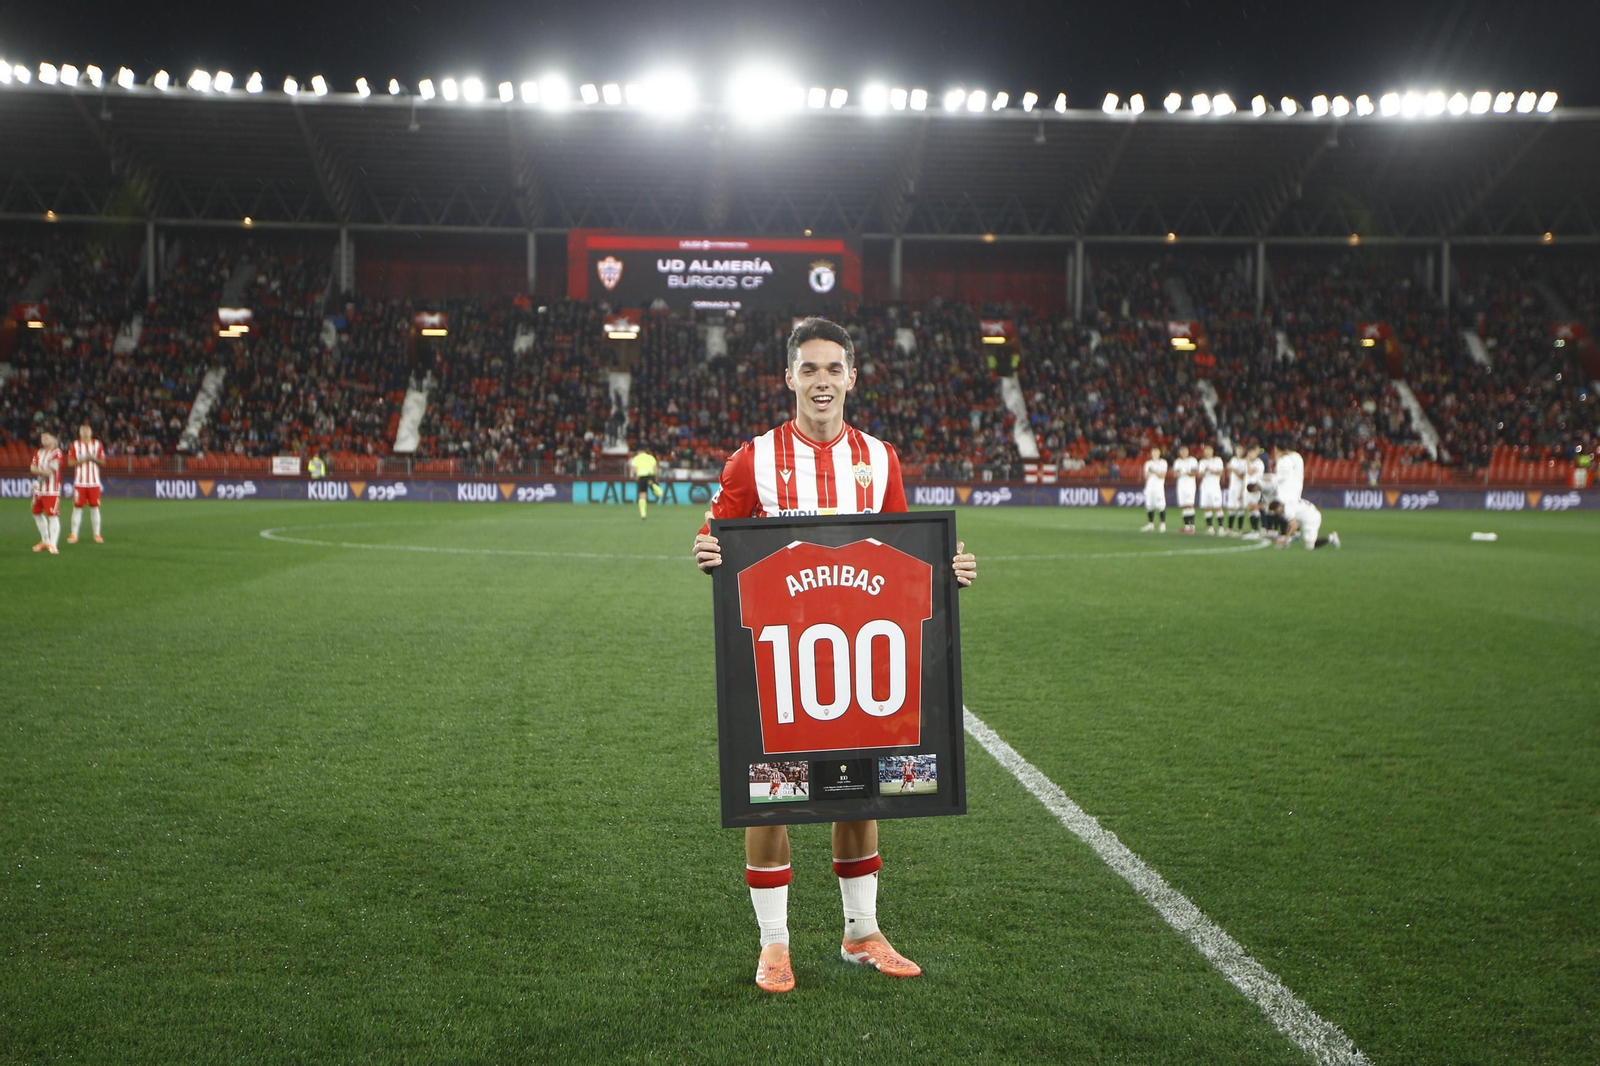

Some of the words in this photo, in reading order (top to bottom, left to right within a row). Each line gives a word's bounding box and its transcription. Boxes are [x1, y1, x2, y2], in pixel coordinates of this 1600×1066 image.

[657, 259, 686, 273] UD
[688, 257, 774, 274] ALMERÍA
[667, 275, 738, 289] BURGOS
[741, 276, 764, 289] CF
[155, 480, 197, 499] KUDU
[308, 482, 348, 501] KUDU
[457, 483, 498, 502] KUDU
[914, 486, 955, 505] KUDU
[1059, 487, 1099, 506] KUDU
[1344, 491, 1383, 510] KUDU
[1485, 491, 1525, 511] KUDU
[785, 564, 885, 597] ARRIBAS
[757, 619, 907, 724] 100
